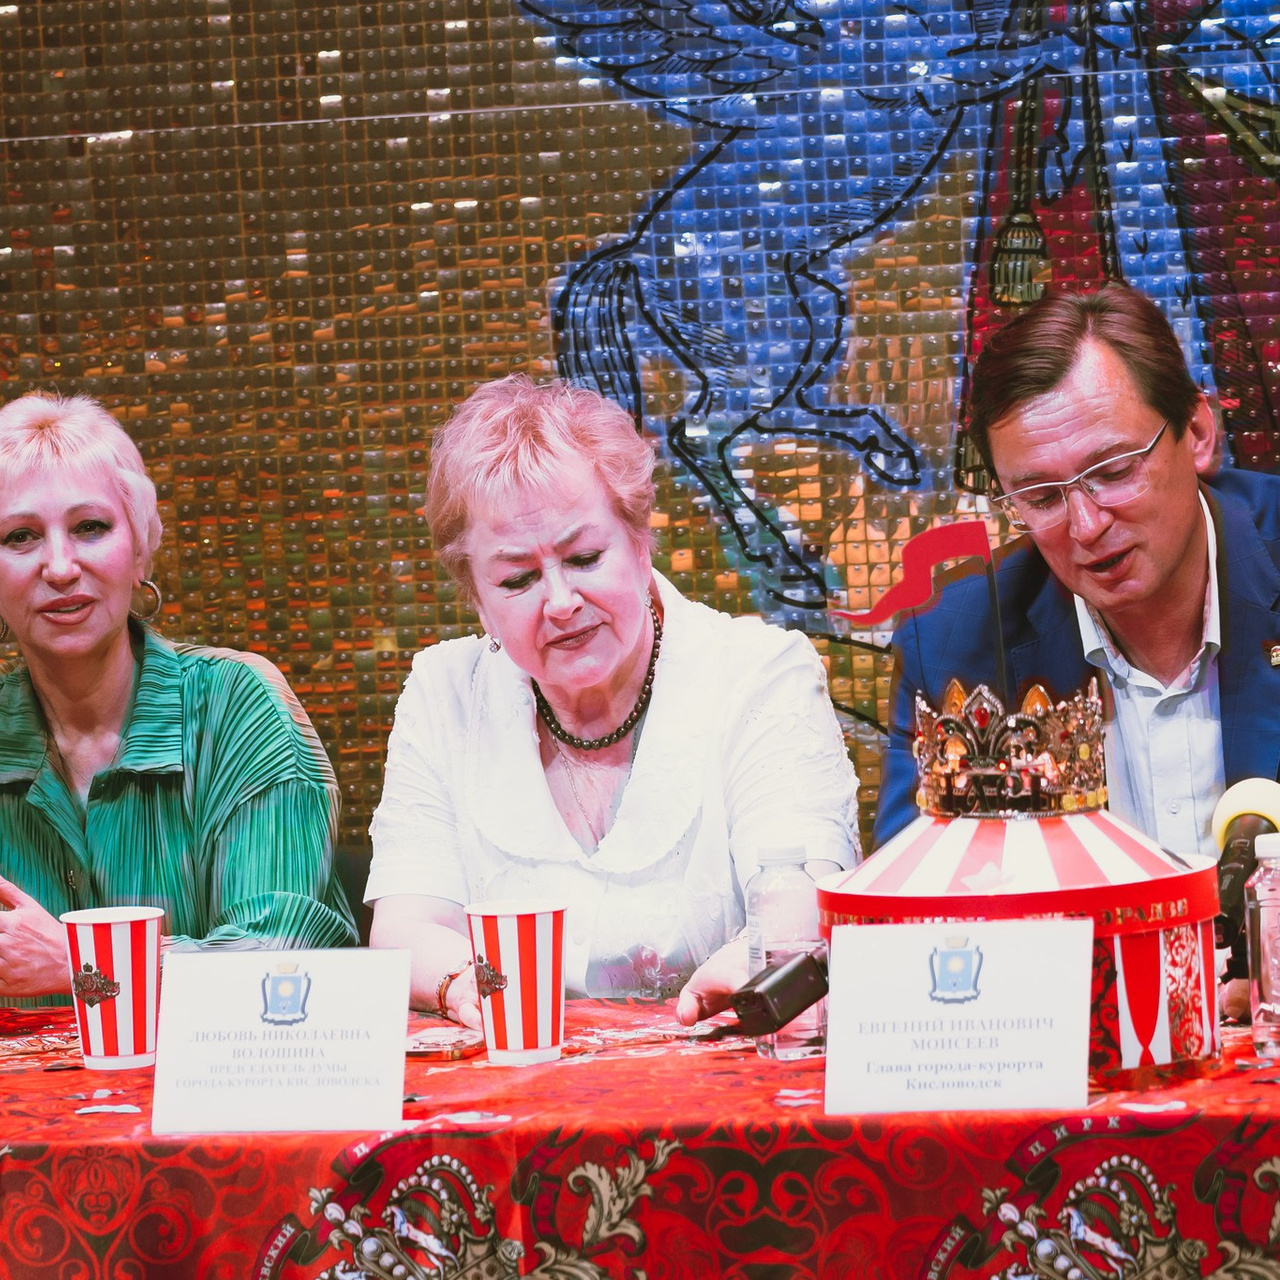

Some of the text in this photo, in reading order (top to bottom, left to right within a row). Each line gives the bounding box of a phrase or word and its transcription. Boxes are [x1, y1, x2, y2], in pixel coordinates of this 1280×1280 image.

[190, 1029, 257, 1043] ЛЮБОВЬ
[866, 1061, 912, 1073] Глава
[906, 1078, 1003, 1091] Кисловодск
[1027, 1115, 1121, 1158] ЦИРК
